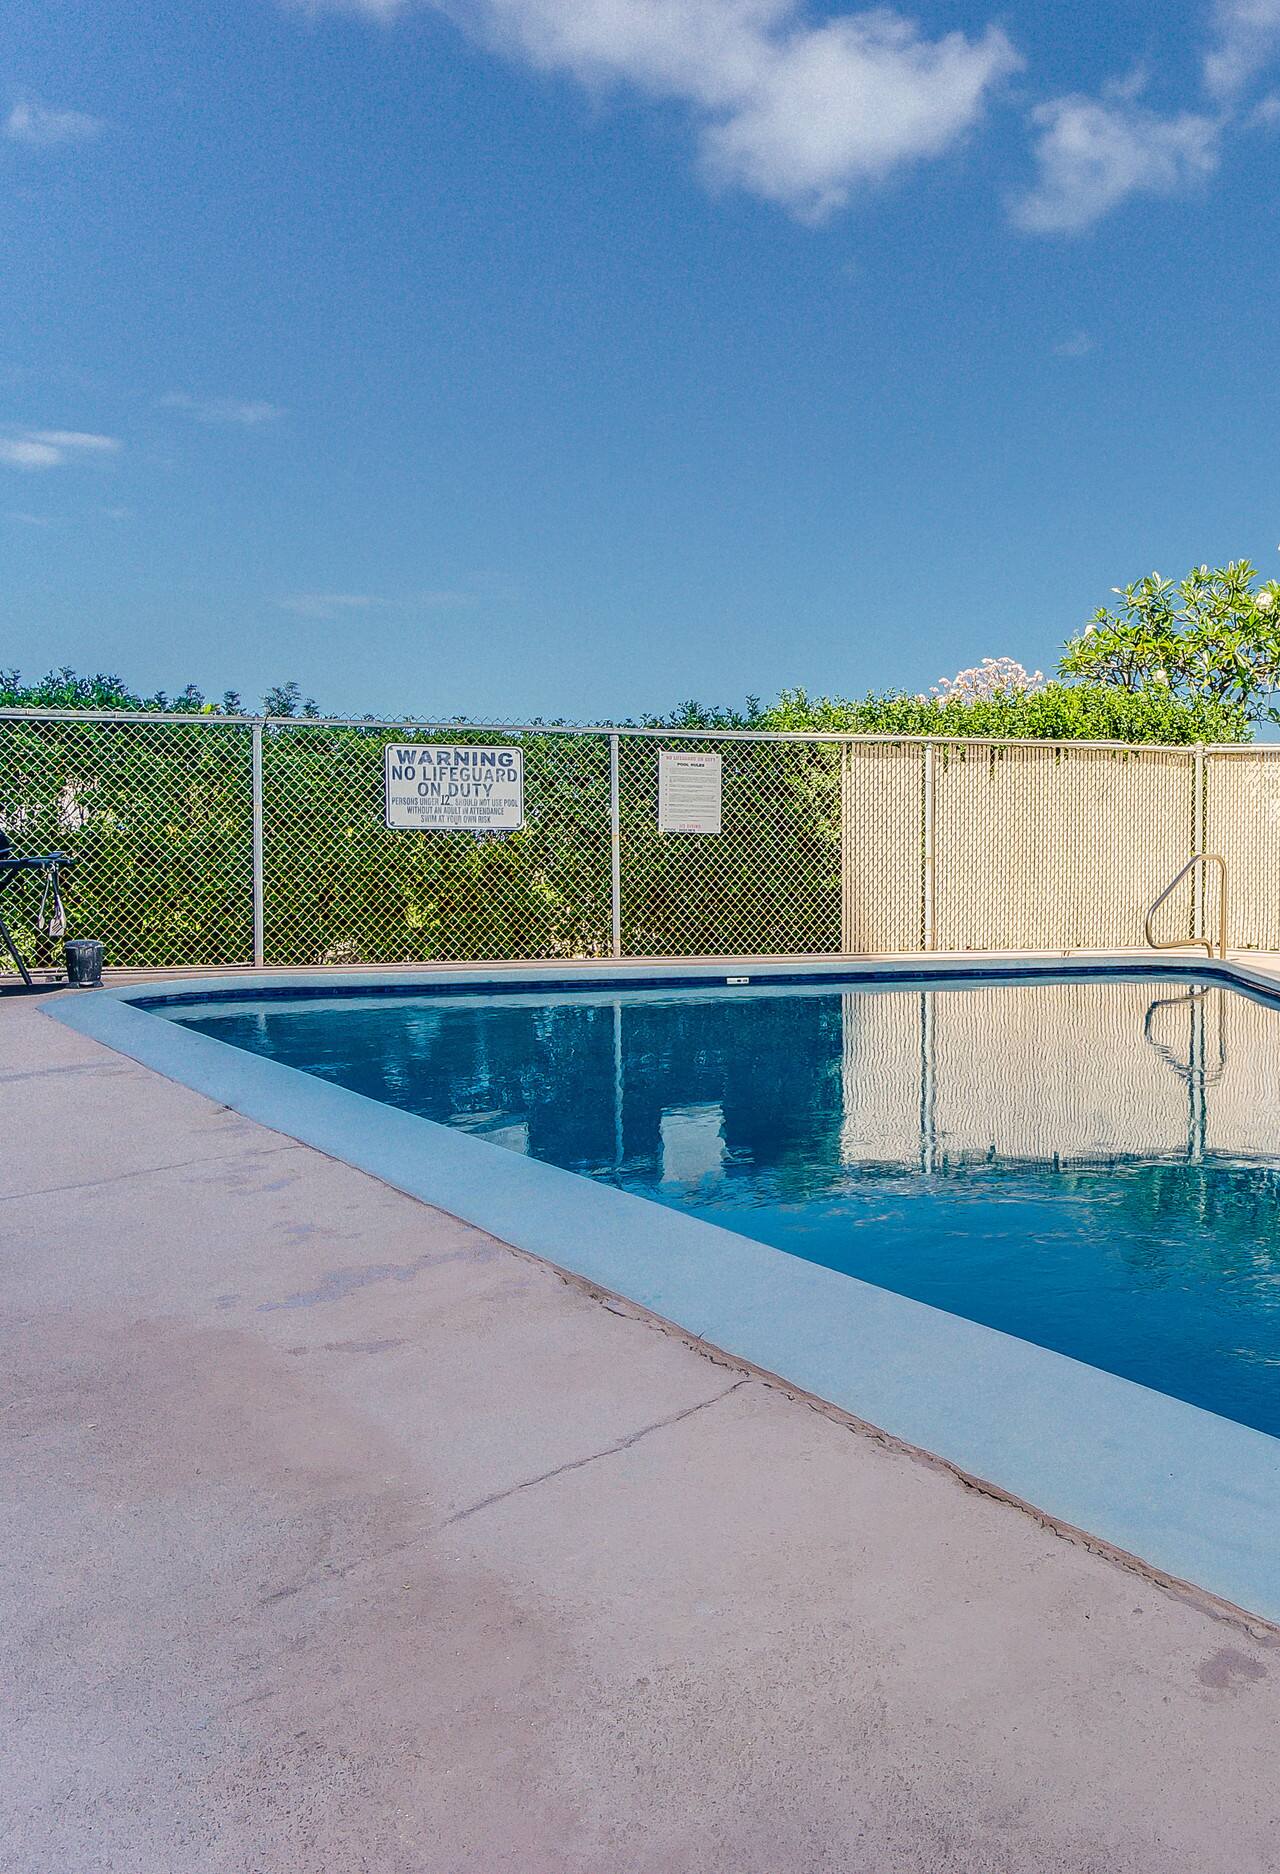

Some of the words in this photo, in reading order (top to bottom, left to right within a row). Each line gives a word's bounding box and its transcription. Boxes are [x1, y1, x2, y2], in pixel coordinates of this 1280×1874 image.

[396, 750, 513, 767] WARNING
[392, 766, 415, 780] NO
[423, 767, 517, 782] LIFEGUARD
[418, 782, 440, 796] ON
[448, 783, 493, 797] DUTY
[392, 797, 418, 805] PERSONS
[407, 806, 432, 814] WITHOUT
[470, 807, 504, 815] ATTENDANCE
[421, 815, 437, 823] SWIM
